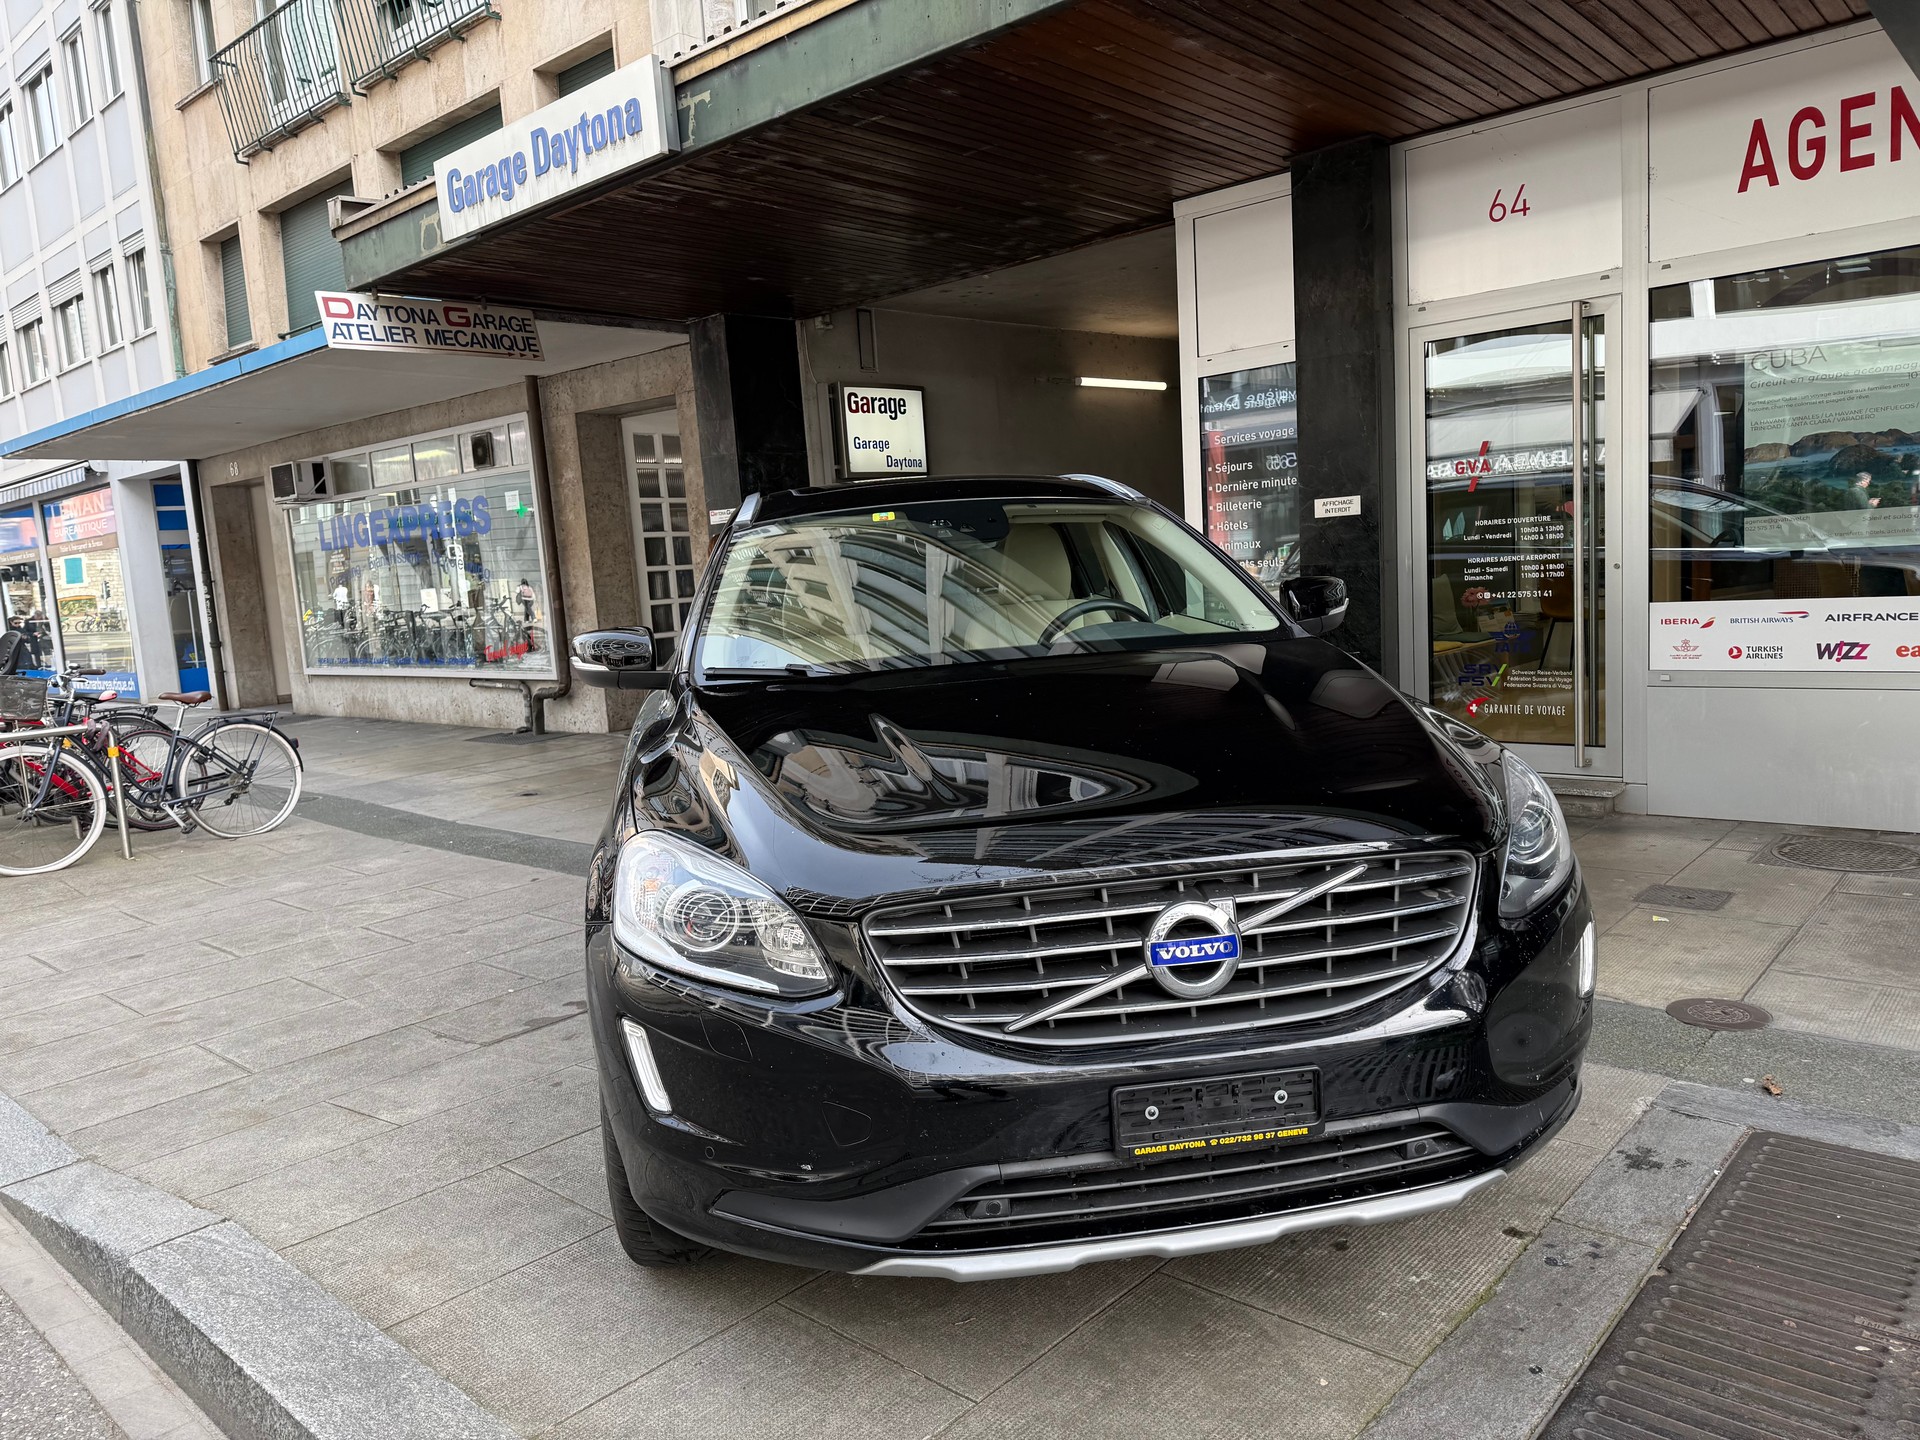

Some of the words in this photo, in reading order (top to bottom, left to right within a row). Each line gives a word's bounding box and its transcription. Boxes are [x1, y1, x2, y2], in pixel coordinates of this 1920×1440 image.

[447, 151, 527, 213] Garage
[530, 98, 642, 177] Daytona
[1488, 183, 1530, 222] 64
[322, 296, 440, 326] DAYTONA
[443, 306, 534, 334] GARAGE
[332, 322, 417, 344] ATELIER
[424, 328, 539, 353] MECANIQUE
[1751, 345, 1827, 371] CUBA
[1750, 379, 1786, 389] Circuit
[1808, 370, 1850, 383] groupe
[847, 392, 906, 420] Garage
[1869, 403, 1915, 413] CIENFUEGOS
[1809, 418, 1831, 426] CLARA
[1837, 414, 1875, 422] VARADERO
[1214, 432, 1256, 445] Services
[1259, 427, 1294, 439] voyage
[854, 436, 889, 452] Garage
[230, 461, 239, 476] 68
[886, 455, 922, 470] Daytona
[1216, 461, 1253, 474] Séjours
[1455, 459, 1490, 474] GVA
[1216, 479, 1258, 493] Dernière
[1262, 475, 1297, 489] minute
[1216, 499, 1262, 512] Billeterie
[1322, 499, 1354, 507] AFFICHAGE
[318, 496, 491, 551] LINGEXPRESS
[1217, 520, 1248, 532] Hôtels
[1508, 516, 1551, 524] D'OUVERTURE
[54, 519, 108, 538] BUREAUTIQUE
[1219, 540, 1261, 551] Animaux
[1258, 557, 1285, 568] seuls
[1468, 556, 1498, 564] HORAIRES
[1825, 612, 1919, 622] AIRFRANCE
[1746, 645, 1783, 653] TURKISH
[1484, 704, 1520, 715] GARANTIE
[1525, 705, 1533, 715] DE
[1537, 705, 1565, 716] VOYAGE
[1156, 941, 1233, 960] VOLVO
[1135, 1145, 1167, 1155] GARAGE
[1170, 1140, 1206, 1151] DAYTONA
[1220, 1135, 1252, 1145] 022/732
[1266, 1132, 1275, 1140] 37
[1278, 1128, 1308, 1138] GENEVE
